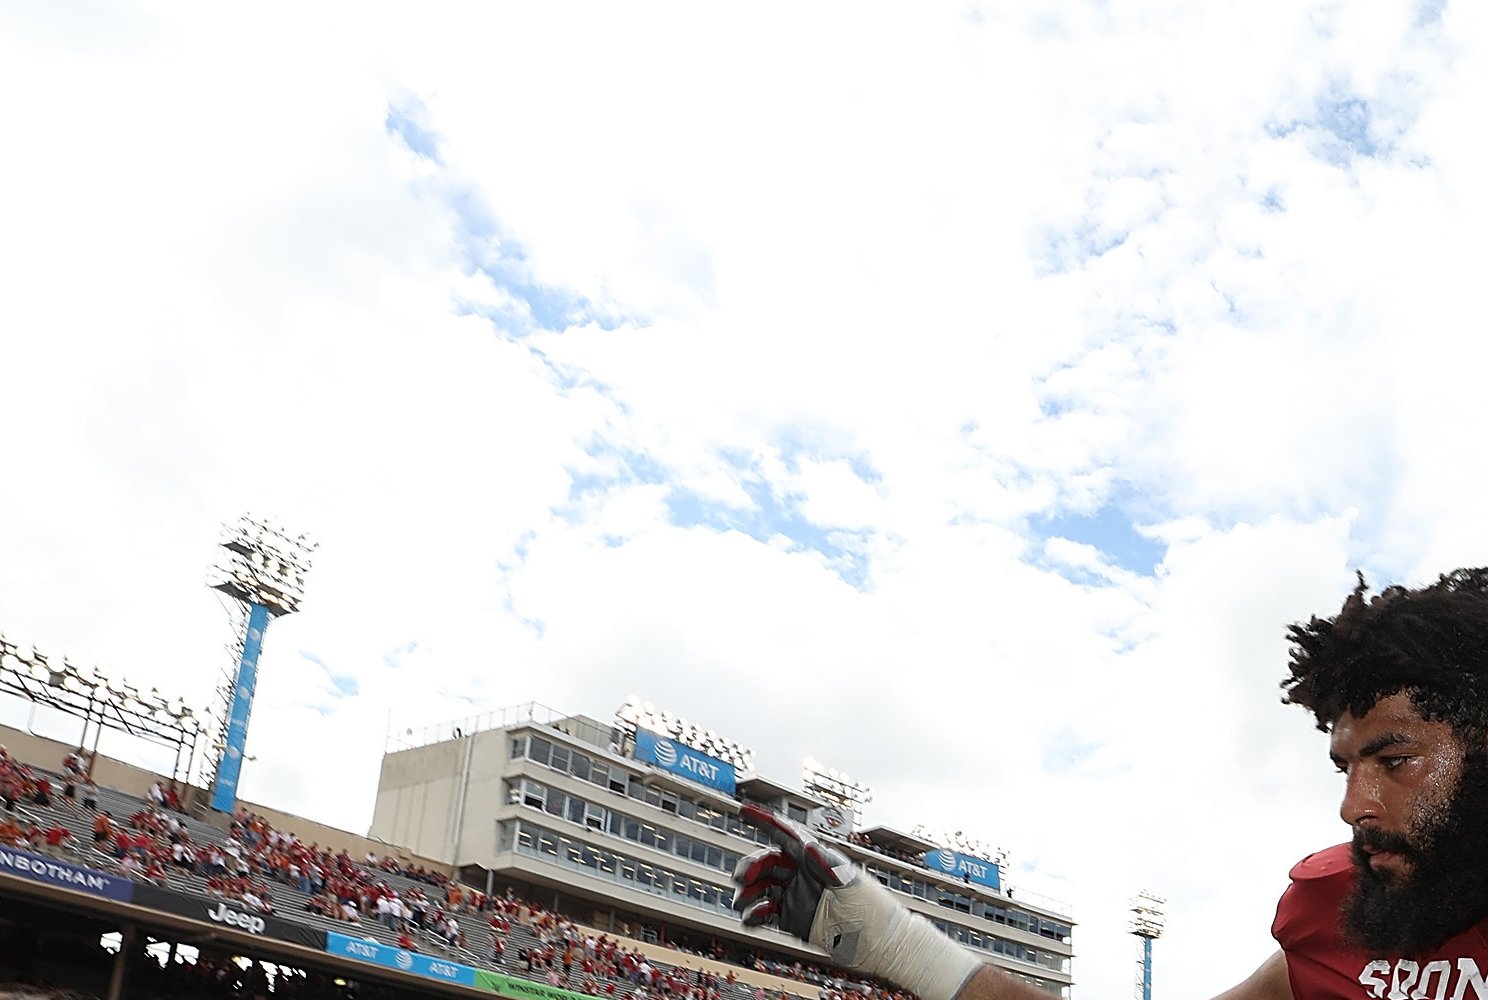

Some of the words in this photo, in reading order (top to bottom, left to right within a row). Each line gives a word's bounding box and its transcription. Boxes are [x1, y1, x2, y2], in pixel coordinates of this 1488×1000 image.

[680, 754, 720, 781] AT&T
[957, 859, 989, 879] AT&T
[207, 902, 267, 935] Jeep
[346, 941, 380, 959] AT&T
[428, 962, 460, 978] AT&T
